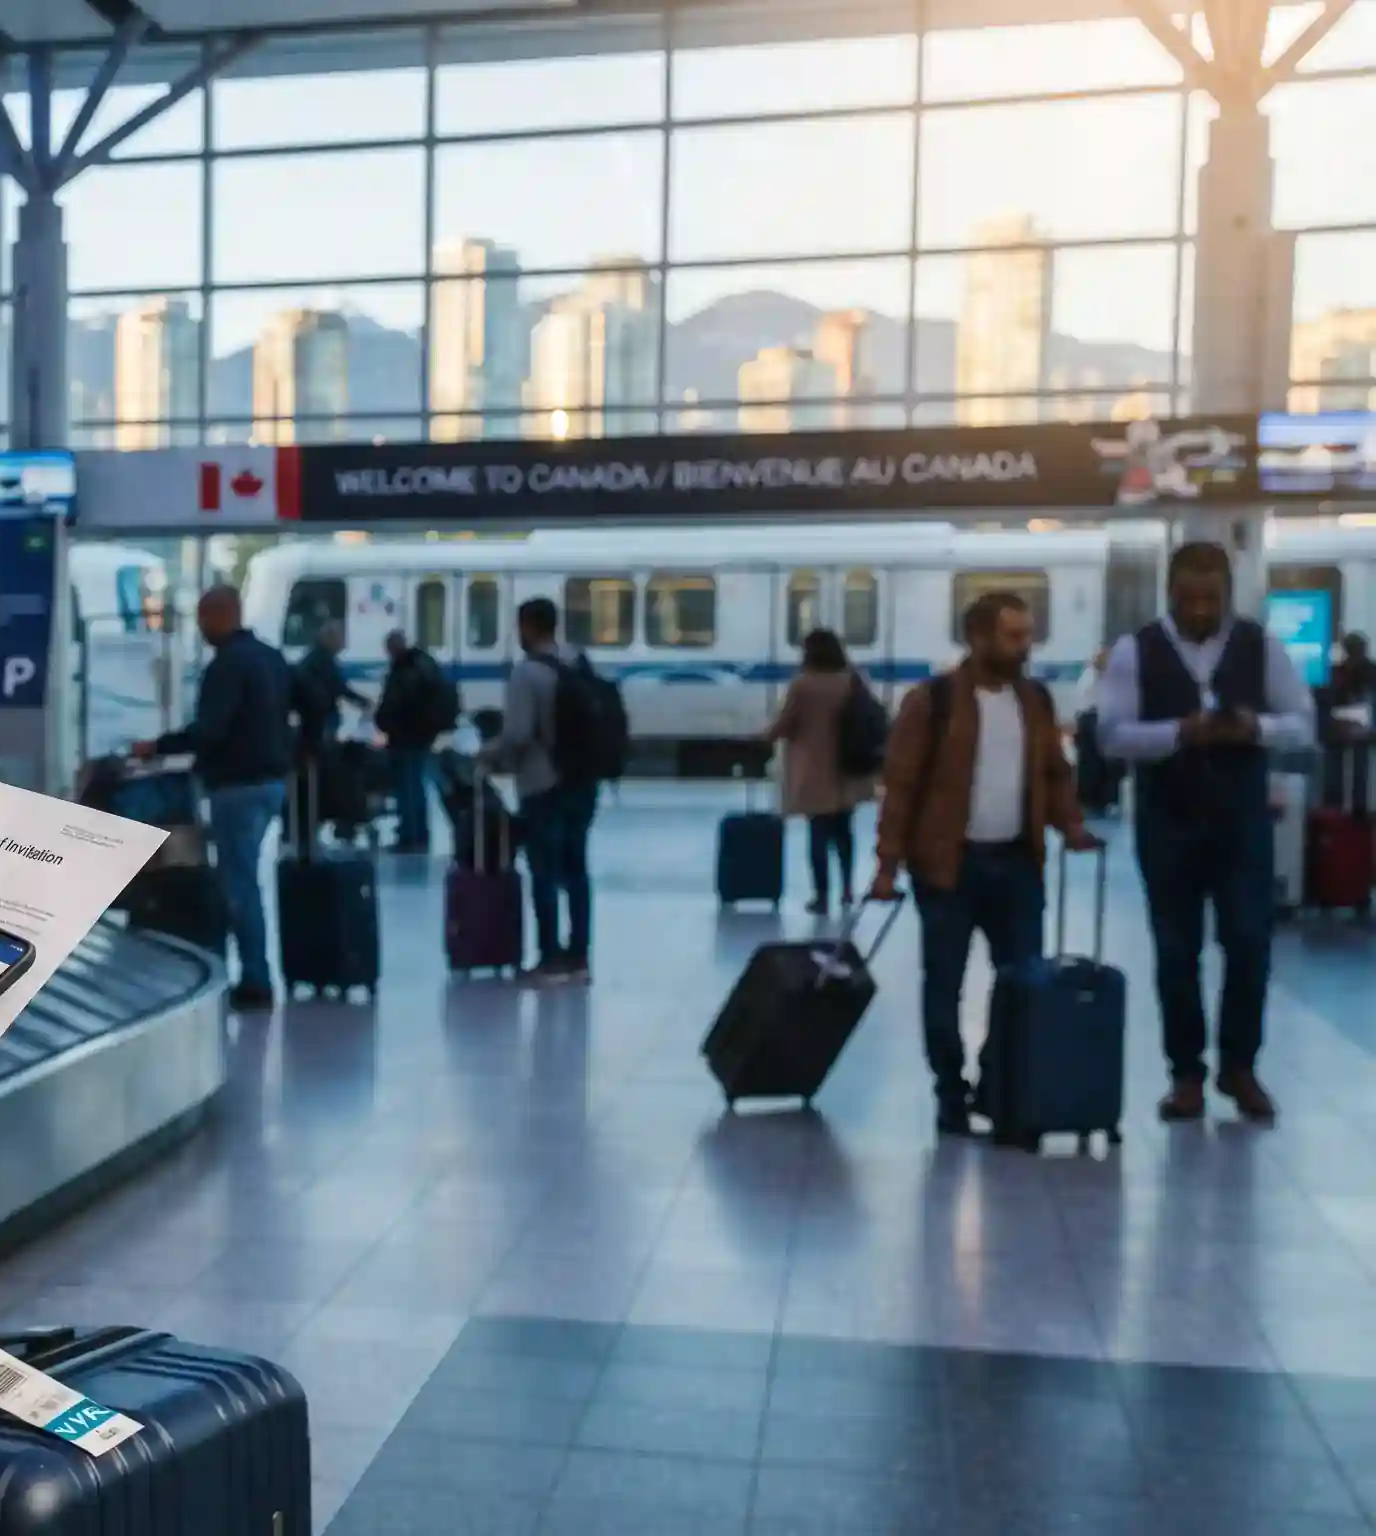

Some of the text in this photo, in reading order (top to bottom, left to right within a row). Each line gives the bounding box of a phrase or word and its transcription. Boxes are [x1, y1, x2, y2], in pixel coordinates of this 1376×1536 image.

[334, 465, 478, 495] WELCOME
[484, 464, 523, 494] TO
[527, 461, 653, 493] CANADA
[850, 455, 897, 486] AU
[900, 451, 1038, 484] CANADA
[3, 656, 36, 697] P
